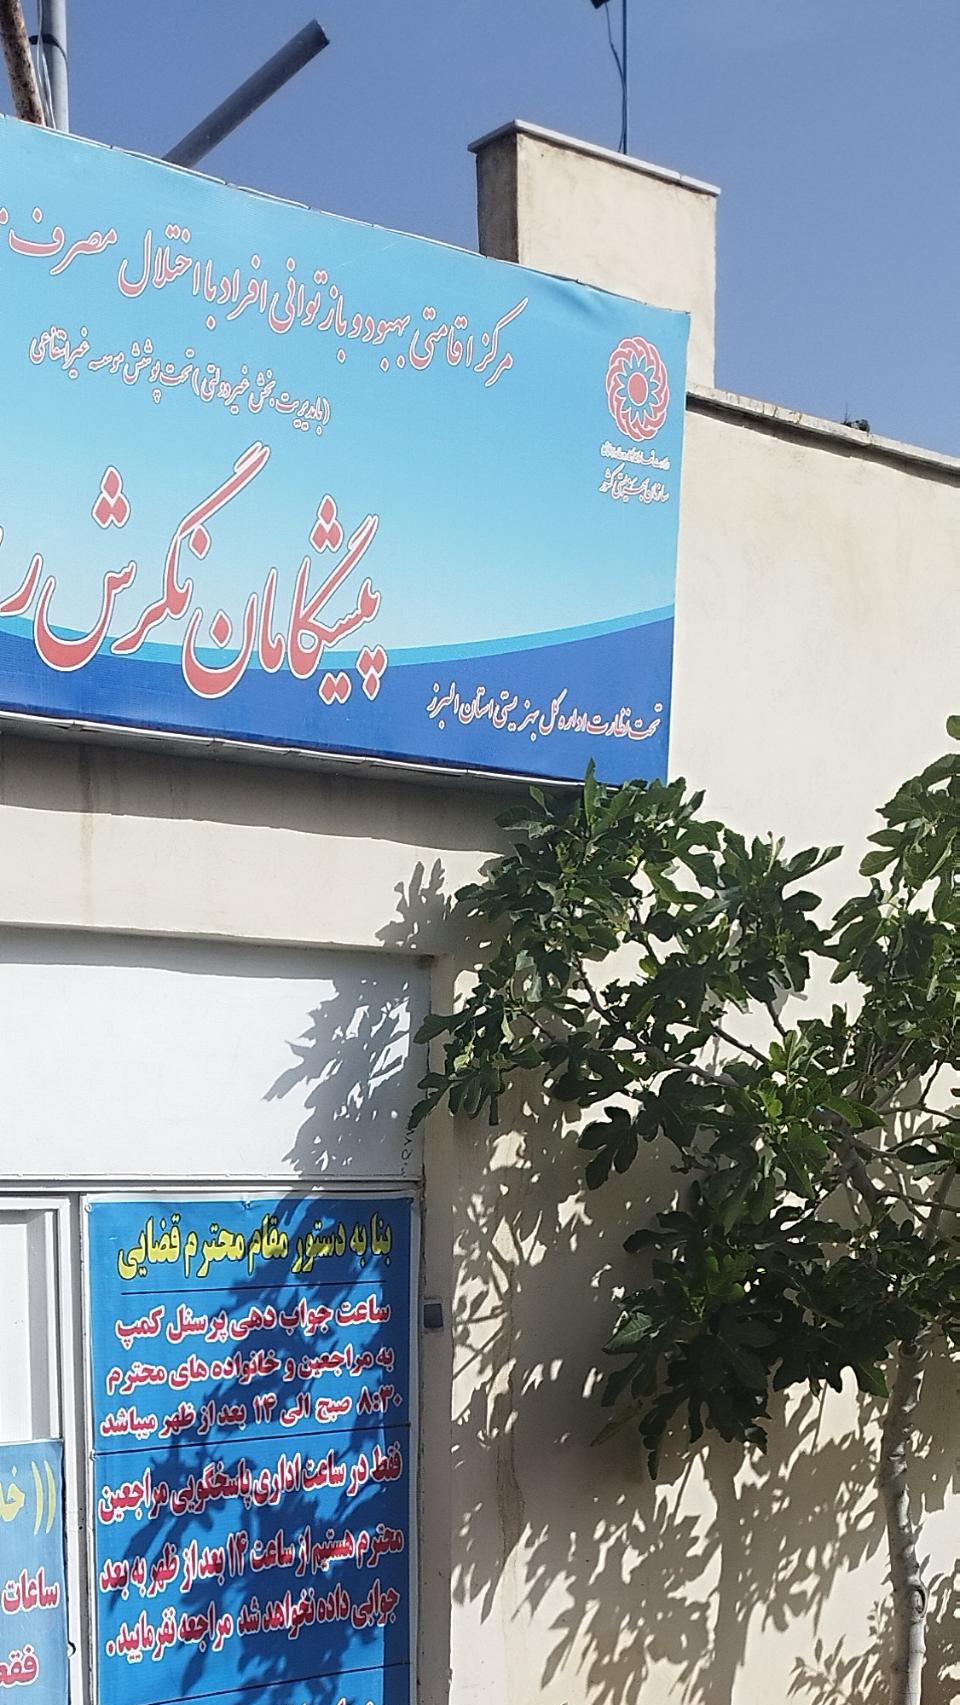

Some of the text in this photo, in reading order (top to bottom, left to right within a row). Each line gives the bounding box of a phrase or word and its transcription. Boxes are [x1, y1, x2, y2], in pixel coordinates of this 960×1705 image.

[8, 207, 117, 275] مصرف
[118, 224, 201, 298] اختلال
[203, 260, 218, 331] با
[217, 254, 268, 321] افراد
[362, 313, 410, 373] بهبود
[409, 307, 473, 371] اقامتی
[475, 298, 528, 388] مرکز
[34, 441, 270, 671] نگرش
[181, 493, 388, 704] پیشگامان
[117, 1212, 391, 1280] بنا به دستور مقام محترم قضایی
[116, 1293, 390, 1348] ساعت جواب دهی پرسنل کمپ
[107, 1343, 395, 1395] به مراجعین و خانواده های محترم
[159, 1402, 197, 1438] ظهر
[253, 1392, 277, 1423] ۱۴
[281, 1392, 310, 1427] الی
[316, 1396, 352, 1423] صبح
[253, 1452, 301, 1506] اداری
[302, 1448, 346, 1491] ساعت
[347, 1453, 369, 1496] در
[370, 1441, 403, 1481] فقط
[99, 1467, 169, 1524] مراجعین
[226, 1530, 249, 1577] ۱۴
[250, 1528, 295, 1572] ساعت
[295, 1525, 311, 1577] از
[312, 1528, 355, 1575] هستیم
[356, 1523, 404, 1569] محترم
[1, 1566, 60, 1614] ساعات
[100, 1558, 129, 1600] بعد
[131, 1556, 147, 1598] به
[318, 1582, 350, 1623] داده
[178, 1601, 234, 1652] مراجعه
[351, 1578, 400, 1630] جوابی
